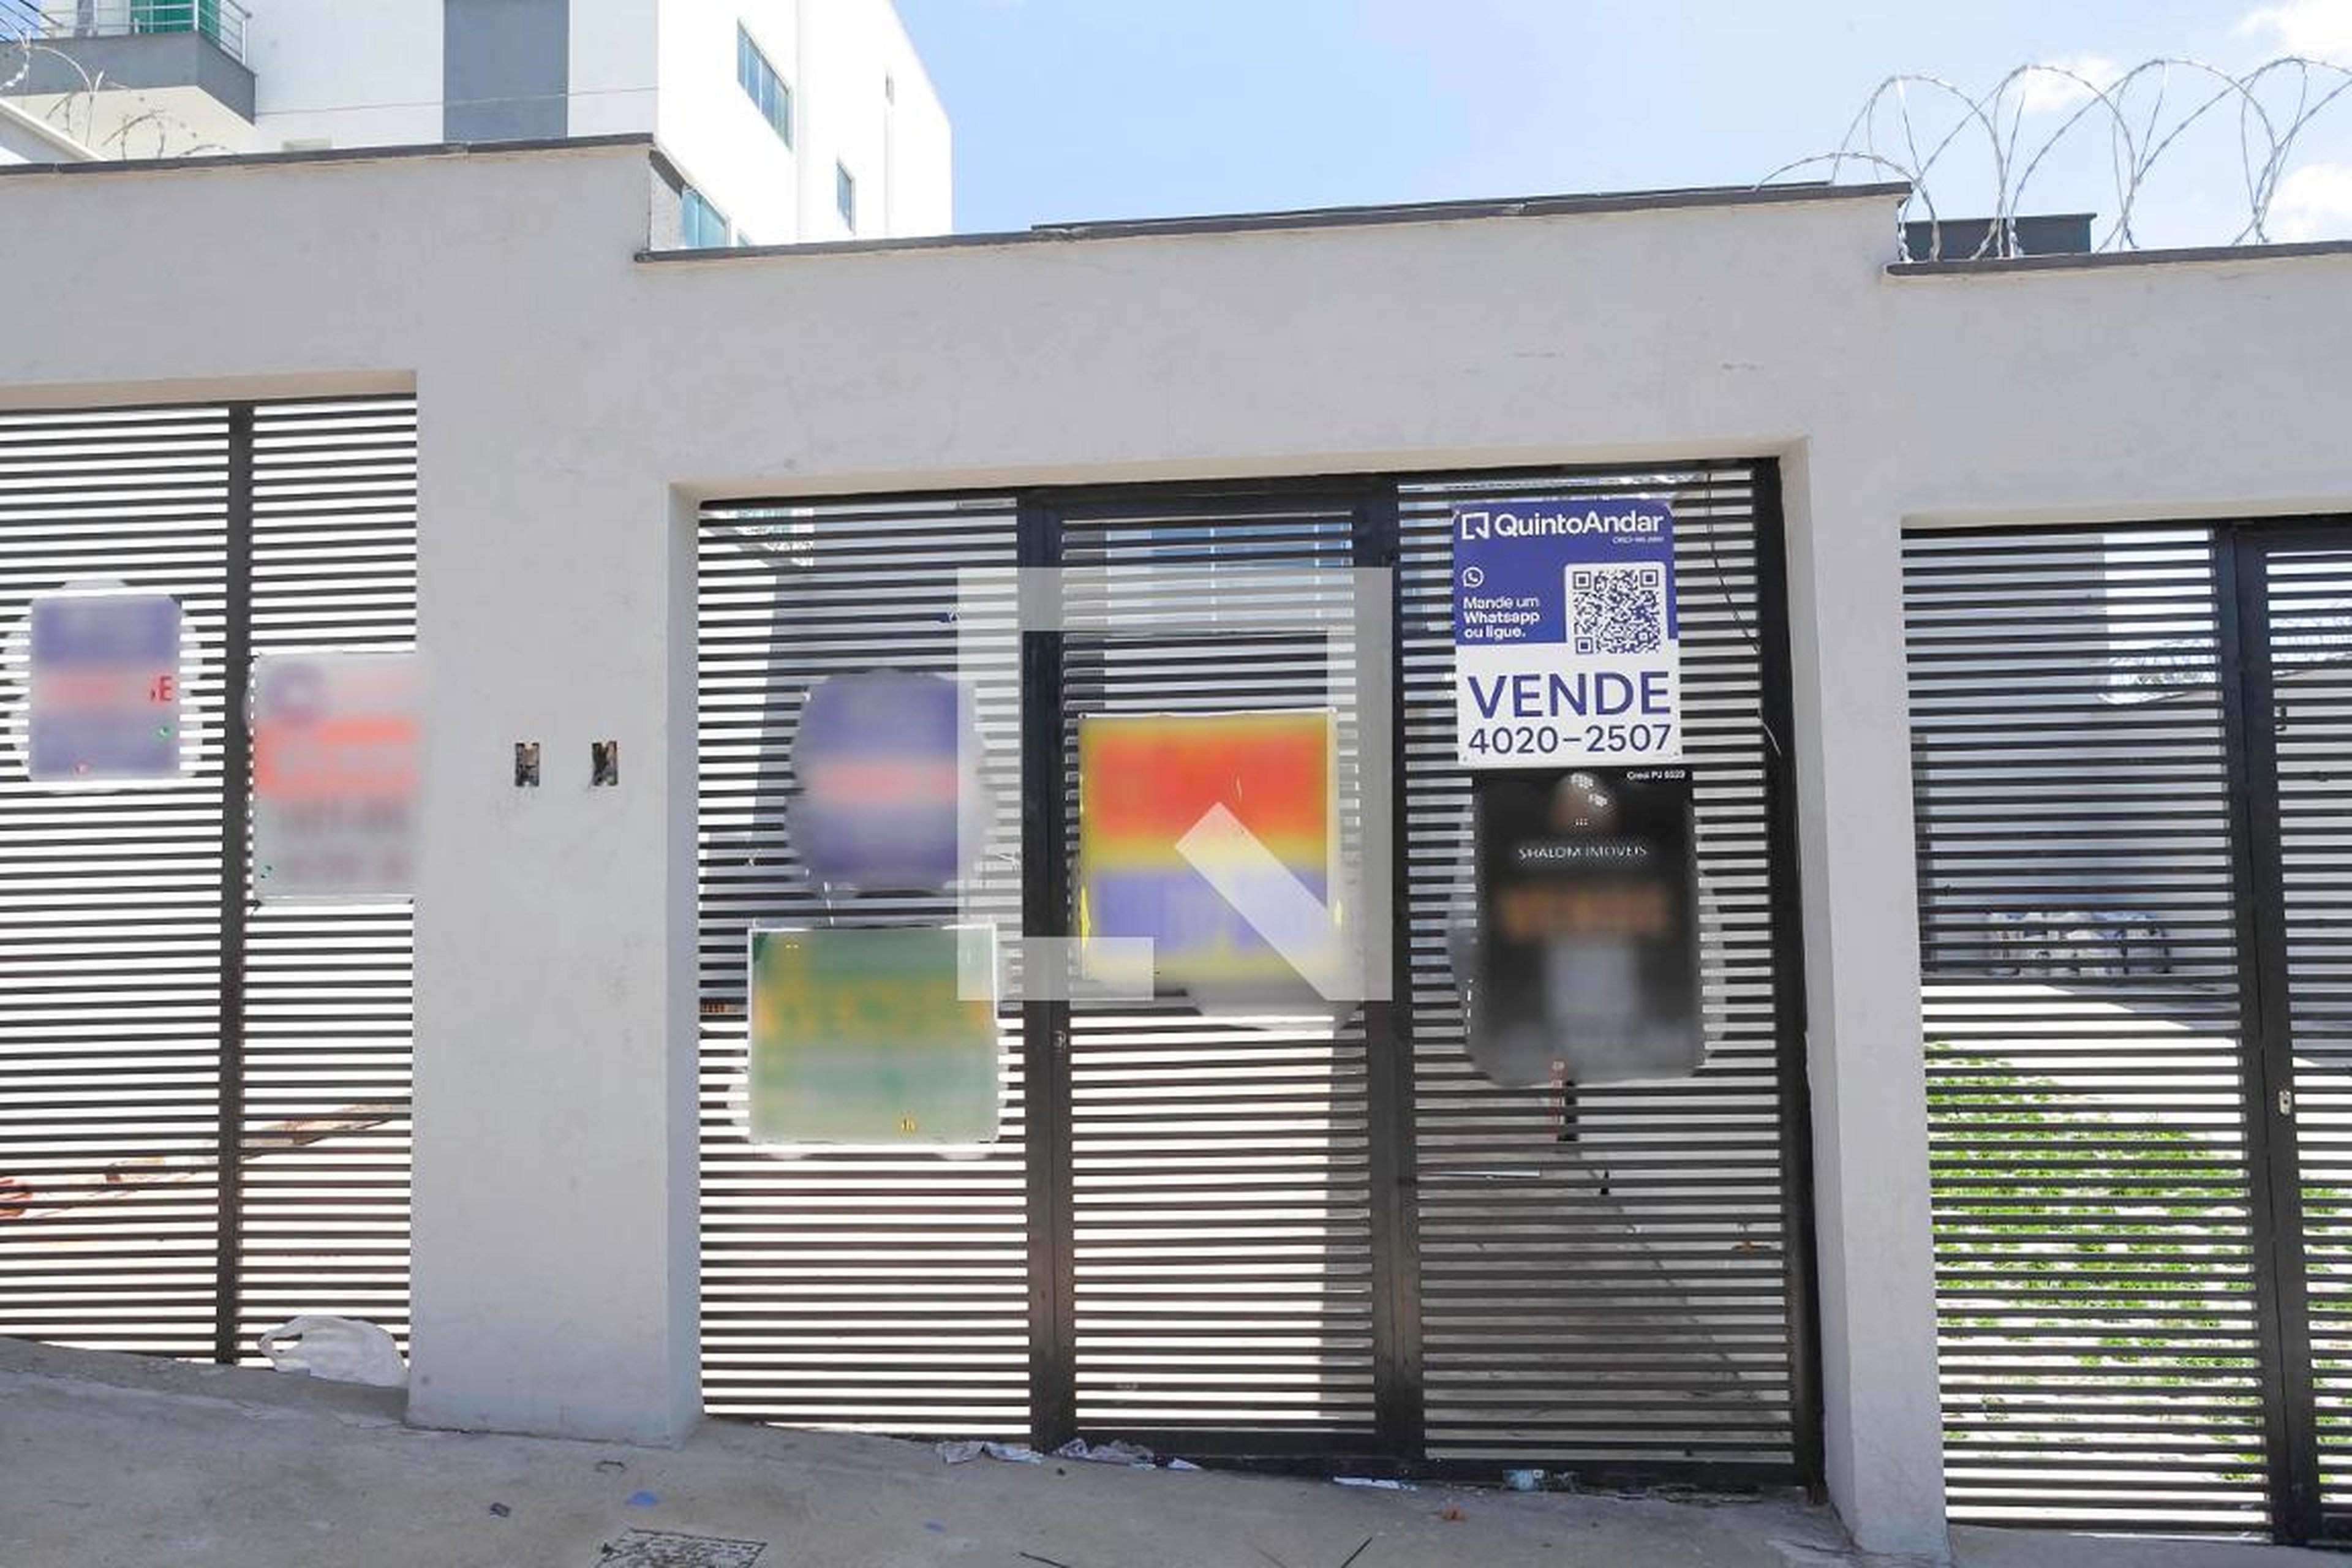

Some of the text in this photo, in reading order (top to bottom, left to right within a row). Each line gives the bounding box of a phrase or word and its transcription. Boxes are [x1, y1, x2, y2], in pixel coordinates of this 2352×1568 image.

[1494, 510, 1664, 537] QuintoAndar
[1463, 596, 1540, 609] Mande um
[1463, 611, 1540, 625] Whatsapp
[1464, 624, 1526, 641] ou ligue.
[1468, 671, 1671, 719] VENDE
[1469, 723, 1672, 755] 4020-2507
[1518, 846, 1581, 859] SHALOM
